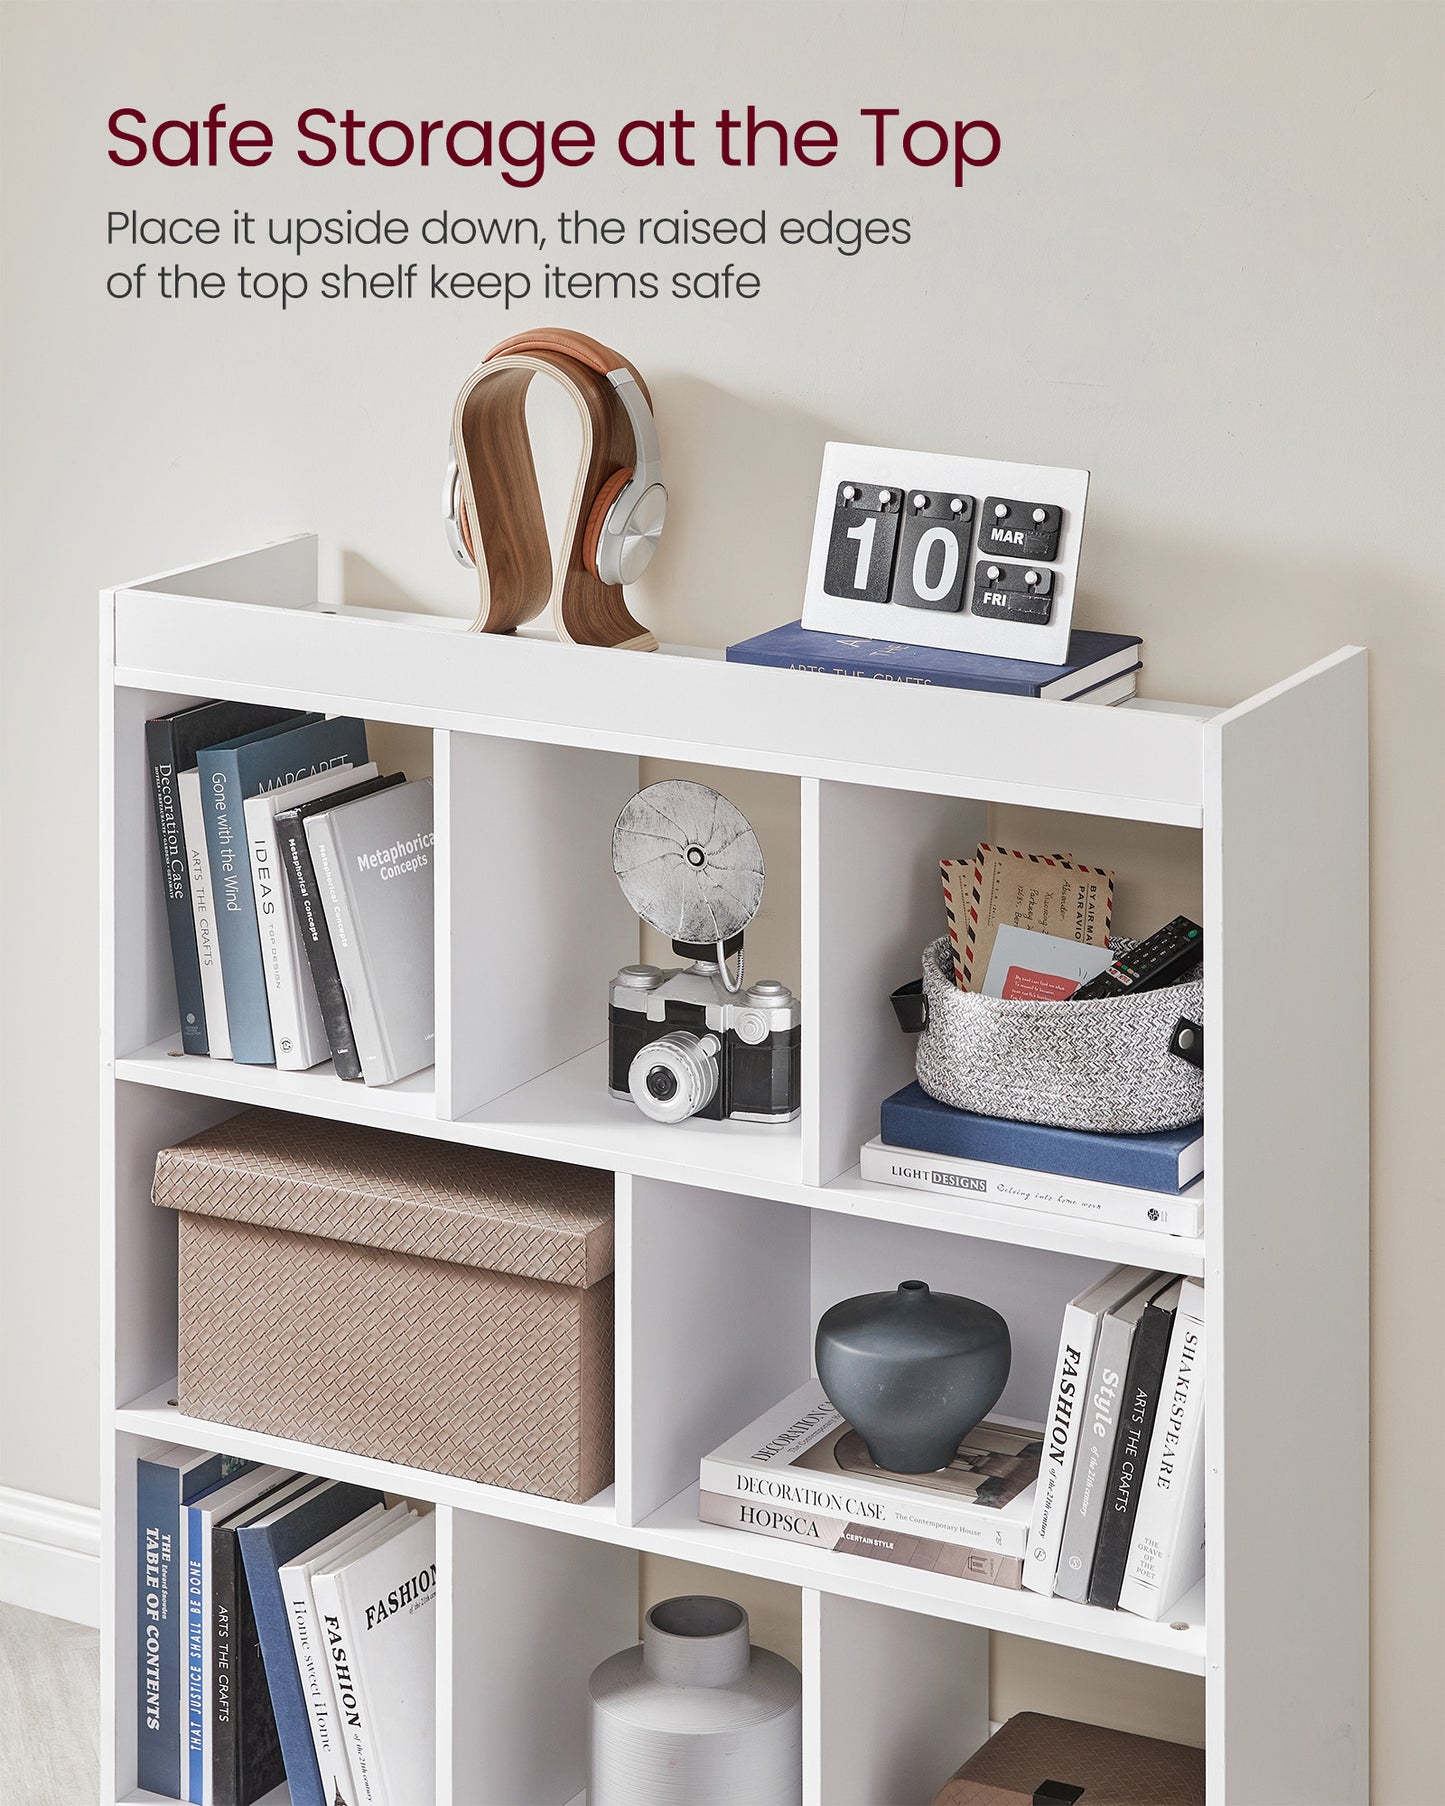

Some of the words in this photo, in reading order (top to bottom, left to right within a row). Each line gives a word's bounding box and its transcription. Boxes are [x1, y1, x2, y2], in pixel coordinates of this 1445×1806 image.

[991, 527, 1024, 546] MAR
[983, 591, 1007, 608] FRI
[212, 772, 227, 811] Gone
[160, 764, 179, 856] Decoration
[171, 859, 184, 899] Case
[217, 814, 233, 844] with
[192, 849, 203, 881] ARTS
[221, 848, 235, 872] the
[380, 853, 428, 881] Concepts
[224, 875, 242, 911] Wind
[255, 840, 275, 915] IDEAS
[288, 838, 308, 897] Metaphorical
[304, 900, 319, 942] Concepts
[196, 887, 207, 912] THE
[319, 844, 338, 903] Metaphorical
[334, 906, 348, 948] Concepts
[1077, 885, 1085, 909] PAR
[200, 918, 213, 966] CRAFTS
[1075, 912, 1083, 942] AVIO
[891, 1165, 930, 1181] LIGHT
[932, 1172, 986, 1191] DESIGNS
[1049, 1344, 1081, 1466] FASHION
[1093, 1368, 1120, 1438] Style
[1132, 1387, 1149, 1424] ARTS
[1157, 1331, 1198, 1490] SHAKESPEARE
[751, 1409, 828, 1461] DECORATION
[1125, 1429, 1142, 1457] THE
[1090, 1446, 1099, 1458] of
[1049, 1467, 1057, 1479] of
[1115, 1461, 1135, 1513] CRAFTS
[737, 1474, 842, 1511] DECORATION
[845, 1498, 886, 1521] CASE
[739, 1505, 820, 1538] HOPSCA
[895, 1512, 908, 1521] The
[909, 1515, 958, 1532] Contemporary
[960, 1525, 981, 1536] House
[146, 1528, 159, 1588] TABLE
[162, 1534, 171, 1561] THE
[846, 1533, 874, 1545] CERTAIN
[874, 1539, 894, 1550] STYLE
[1137, 1543, 1163, 1559] GRAVE
[1144, 1537, 1160, 1548] THE
[190, 1561, 201, 1595] DONE
[146, 1593, 160, 1622] OF
[190, 1600, 201, 1614] BE
[218, 1605, 228, 1638] ARTS
[190, 1623, 201, 1658] SHALL
[218, 1643, 229, 1670] THE
[146, 1624, 160, 1731] CONTENTS
[293, 1600, 310, 1650] Home
[304, 1655, 321, 1697] sweet
[314, 1703, 331, 1752] Home
[324, 1615, 362, 1728] FASHION
[190, 1667, 201, 1714] JUSTICE
[218, 1675, 229, 1722] CRAFTS
[190, 1722, 201, 1751] THAT
